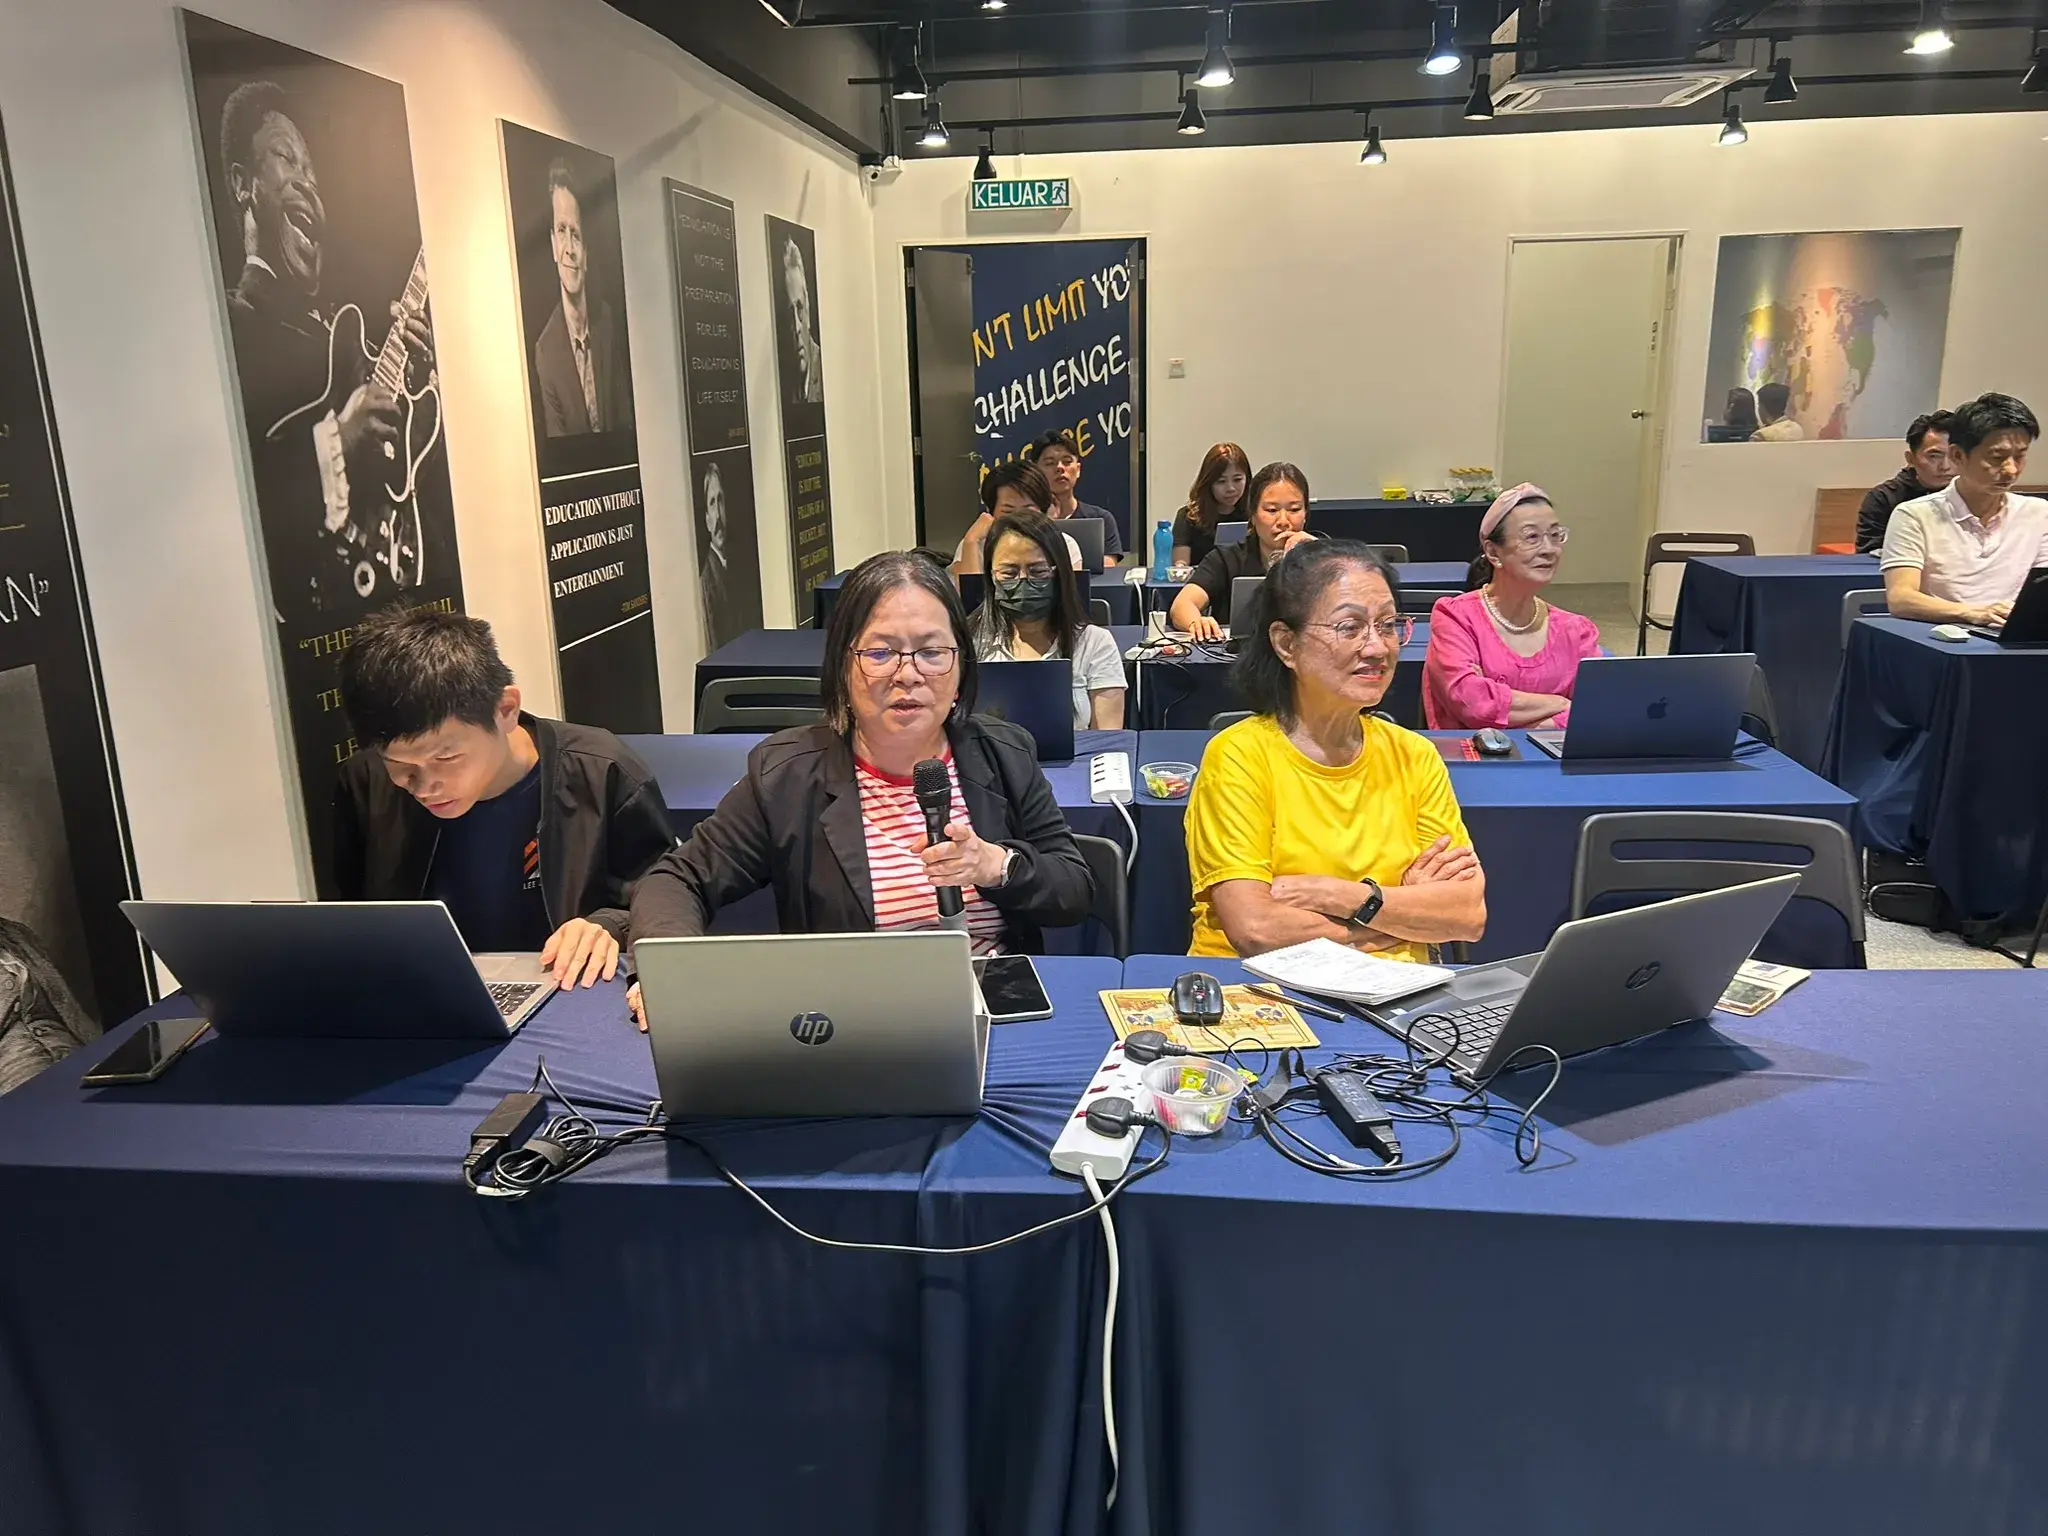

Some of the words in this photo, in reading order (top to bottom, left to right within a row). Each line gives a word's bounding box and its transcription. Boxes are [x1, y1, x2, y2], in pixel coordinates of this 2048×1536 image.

[975, 182, 1048, 207] KELUAR
[1023, 278, 1086, 341] LIMIT
[1091, 258, 1130, 309] YO
[974, 335, 1130, 434] CHALLENGE
[544, 497, 602, 526] EDUCATION
[602, 488, 641, 512] WITHOUT
[550, 531, 607, 561] APPLICATION
[608, 529, 617, 545] IS
[617, 524, 634, 543] JUST
[553, 561, 624, 598] ENTERTAINMENT
[523, 880, 536, 890] LEE
[796, 1012, 829, 1047] hp
